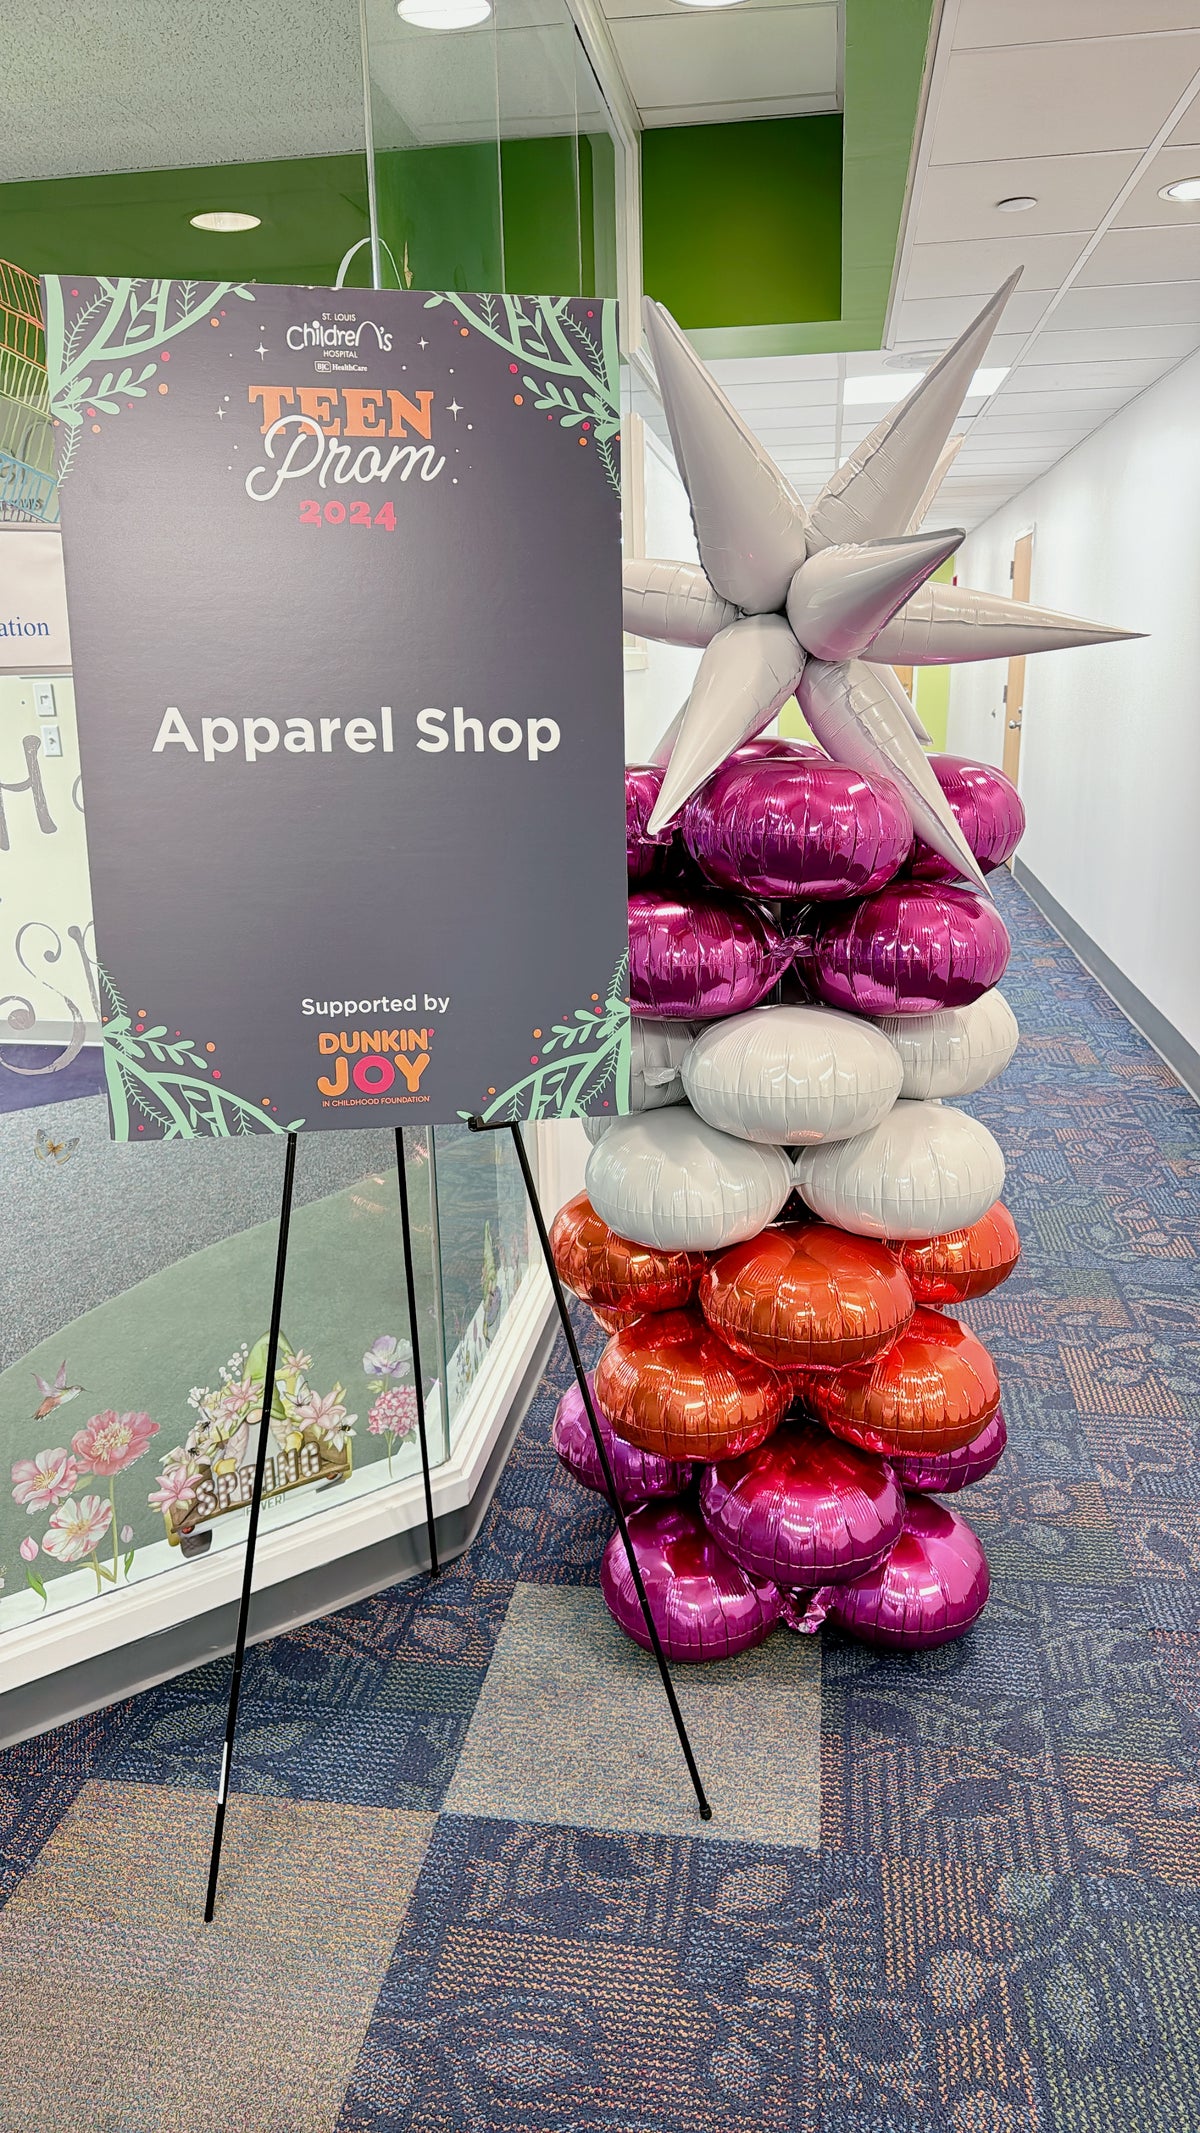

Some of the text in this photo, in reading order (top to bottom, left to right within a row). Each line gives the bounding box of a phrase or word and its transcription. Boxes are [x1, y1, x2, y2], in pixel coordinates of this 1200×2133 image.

[322, 312, 357, 322] ST. LOUIS
[286, 320, 393, 352] Children's
[317, 362, 368, 372] BJC HealthCare
[323, 350, 358, 359] HOSPITAL
[248, 385, 434, 440] TEEN
[245, 414, 446, 502] Prom
[299, 500, 397, 532] 2024
[152, 706, 561, 762] Apparel Shop
[301, 994, 450, 1018] Supported by
[318, 1028, 435, 1055] DUNKIN'
[317, 1053, 431, 1097] JOY
[322, 1095, 431, 1108] IN CHILDHOOD FOUNDATION
[246, 1494, 283, 1517] FVER
